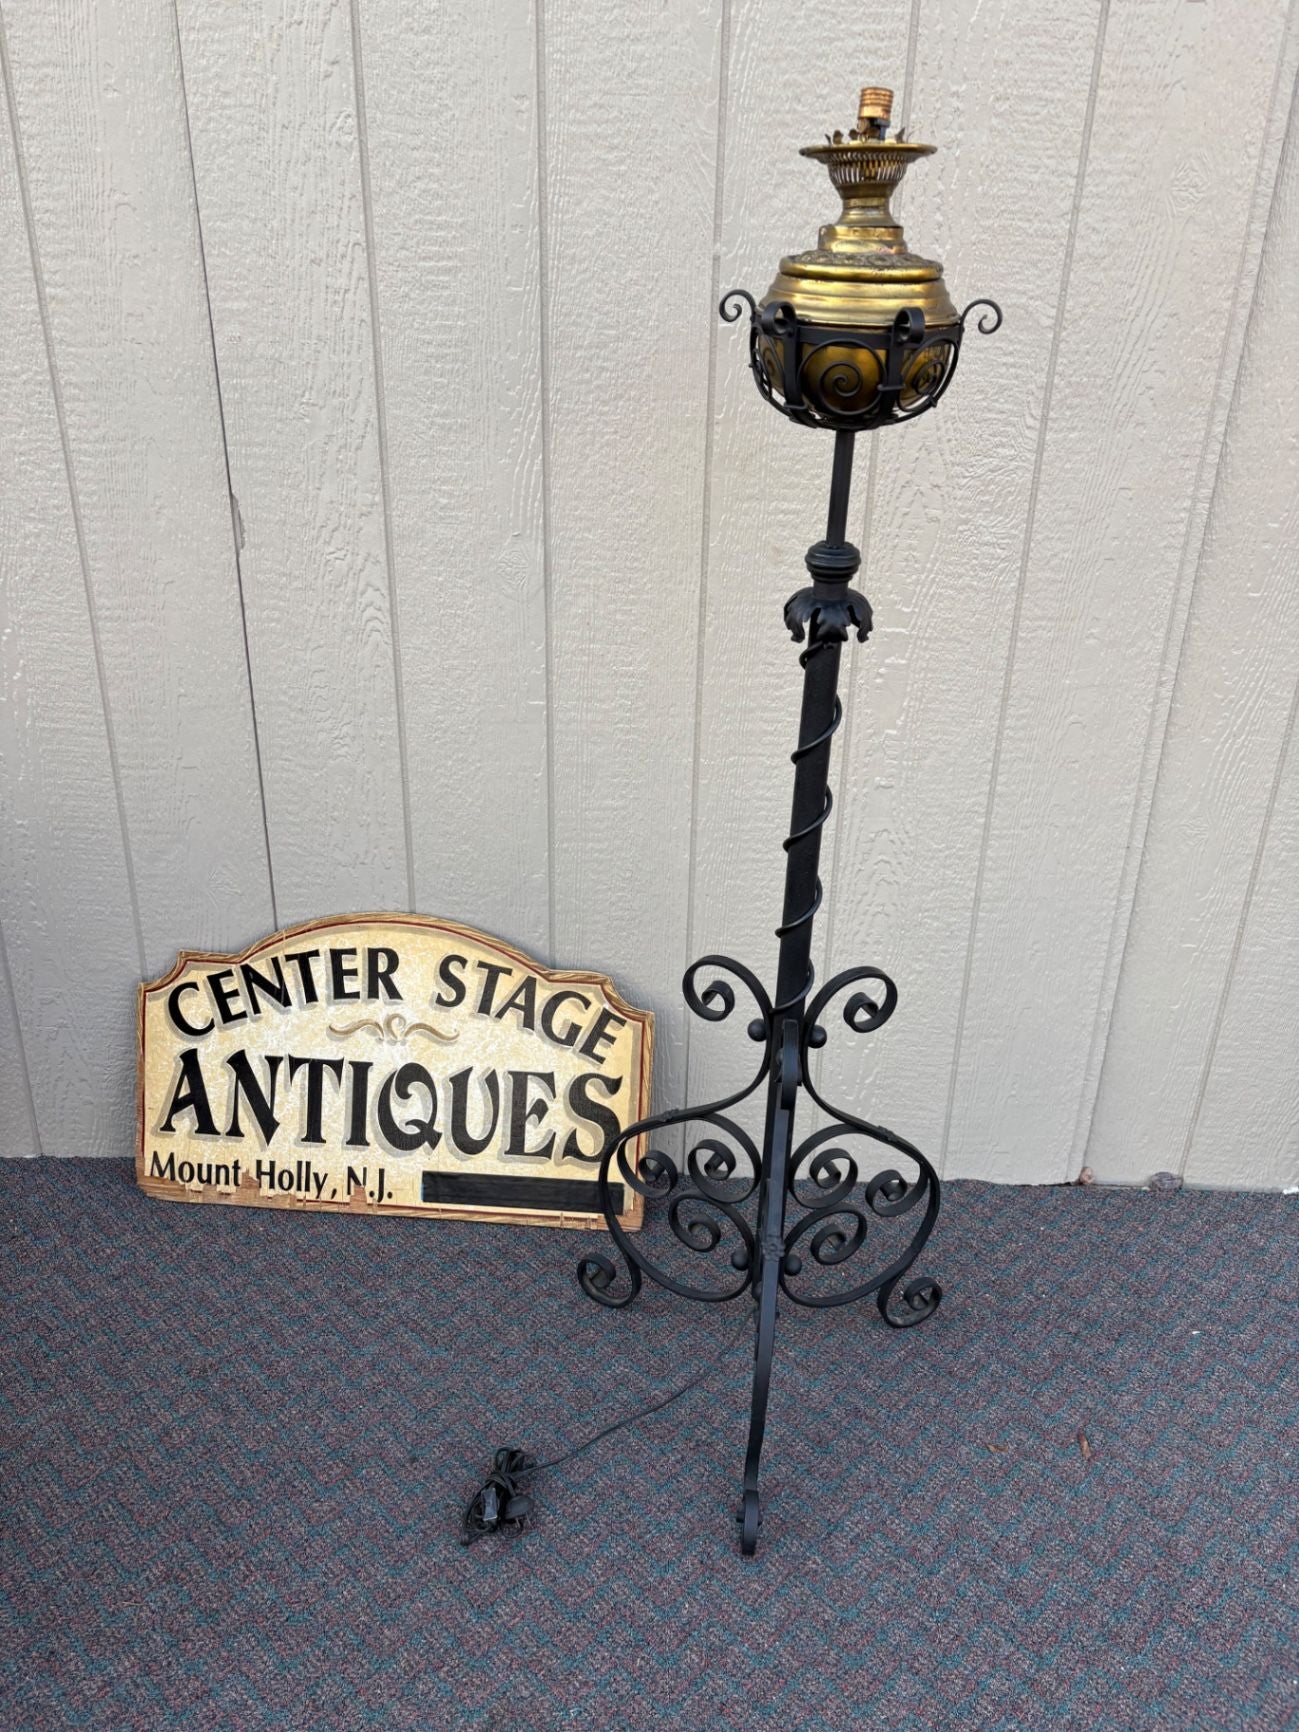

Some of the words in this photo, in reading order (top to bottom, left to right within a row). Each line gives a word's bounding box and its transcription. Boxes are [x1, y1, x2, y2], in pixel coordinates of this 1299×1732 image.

[168, 947, 403, 1037] CENTER
[435, 954, 627, 1064] STAGE
[159, 1048, 623, 1163] ANTIQUES
[150, 1150, 240, 1187] Mount
[255, 1159, 337, 1198] Holly,
[346, 1166, 393, 1203] N.J.
